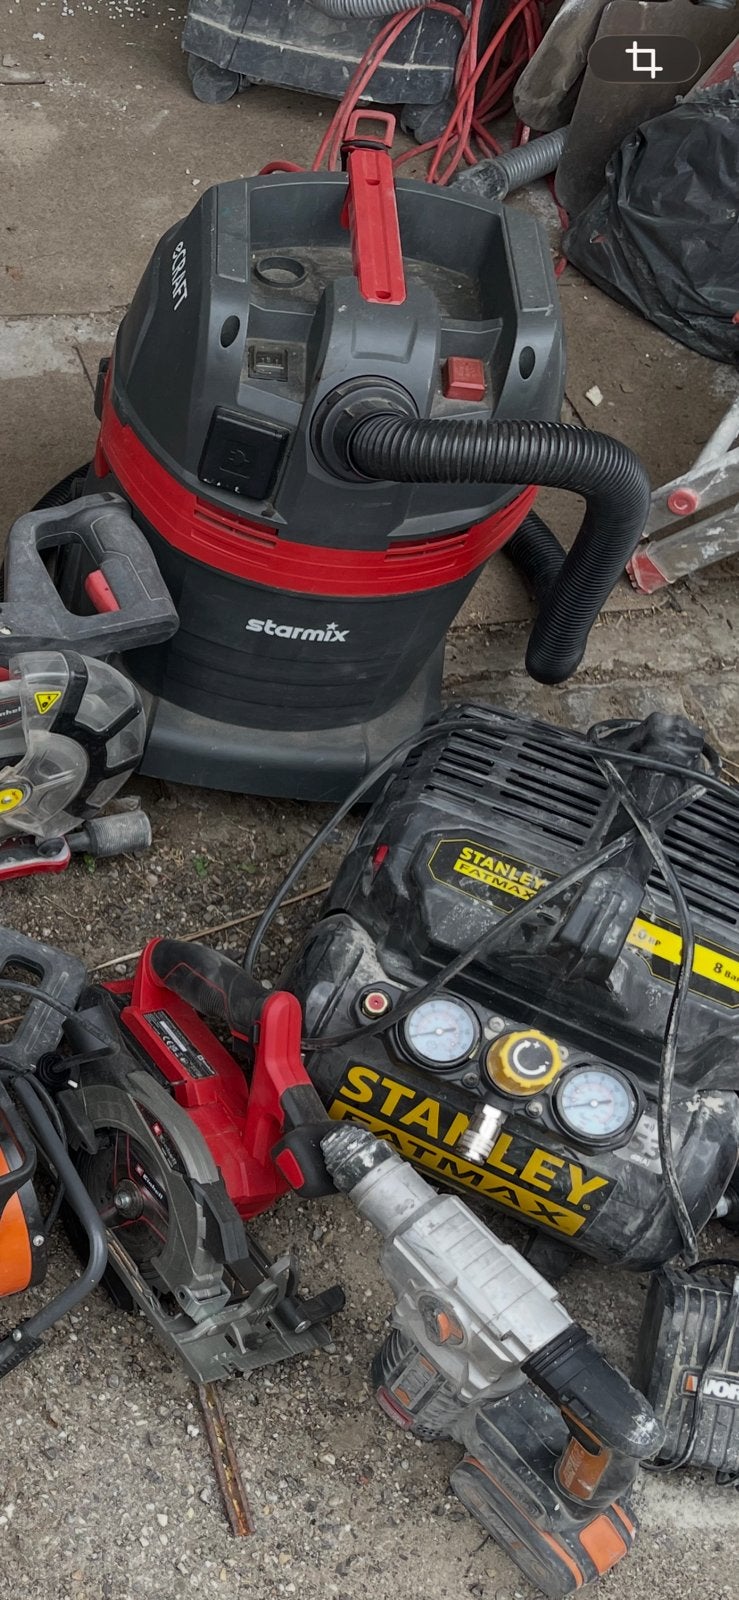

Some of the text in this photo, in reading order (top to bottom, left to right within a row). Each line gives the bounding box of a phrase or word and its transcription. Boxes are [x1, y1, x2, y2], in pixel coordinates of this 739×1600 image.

[245, 618, 350, 642] starmix
[459, 846, 547, 890] STANLEY
[459, 863, 535, 899] FATMAX
[713, 962, 723, 974] 8
[703, 1378, 739, 1401] WOR
